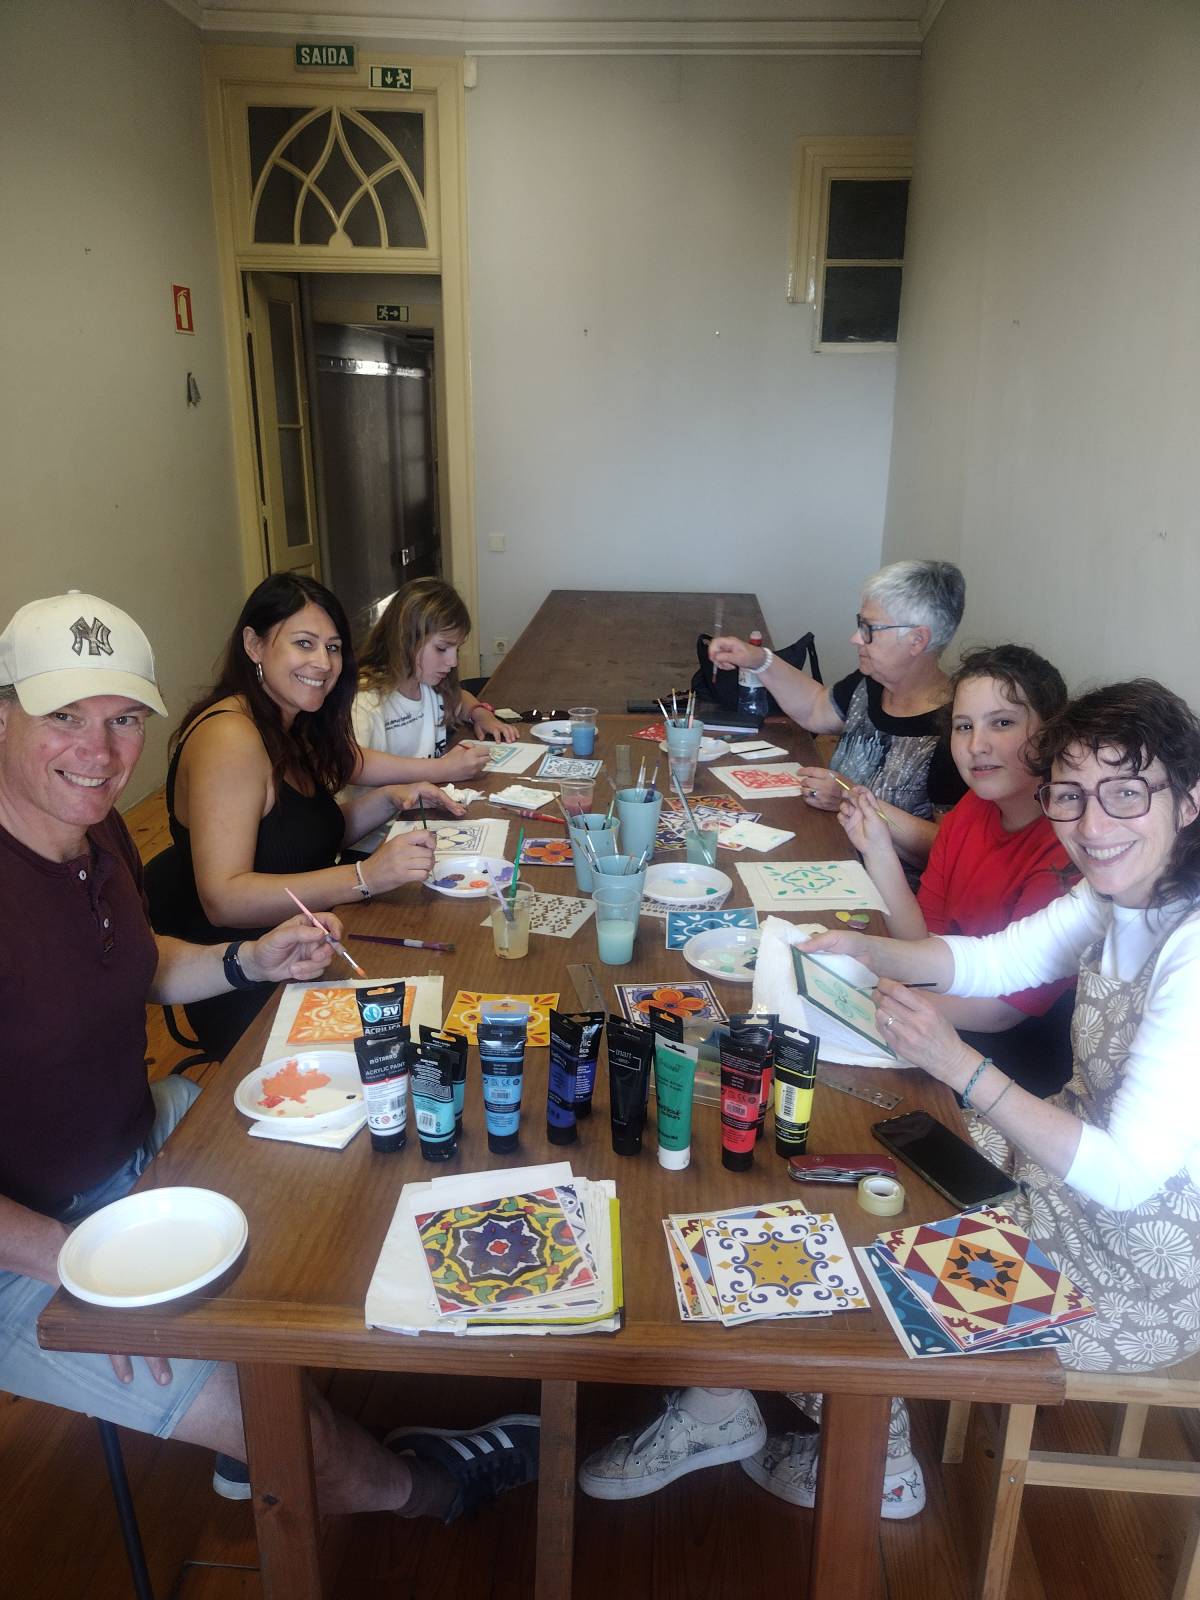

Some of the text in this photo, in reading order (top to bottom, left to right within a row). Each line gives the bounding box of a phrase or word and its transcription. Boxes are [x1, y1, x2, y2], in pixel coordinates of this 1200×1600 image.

[301, 46, 349, 65] SAÍDA
[69, 615, 114, 657] NY
[383, 1005, 399, 1017] SV
[365, 1064, 390, 1076] ACRYLIC
